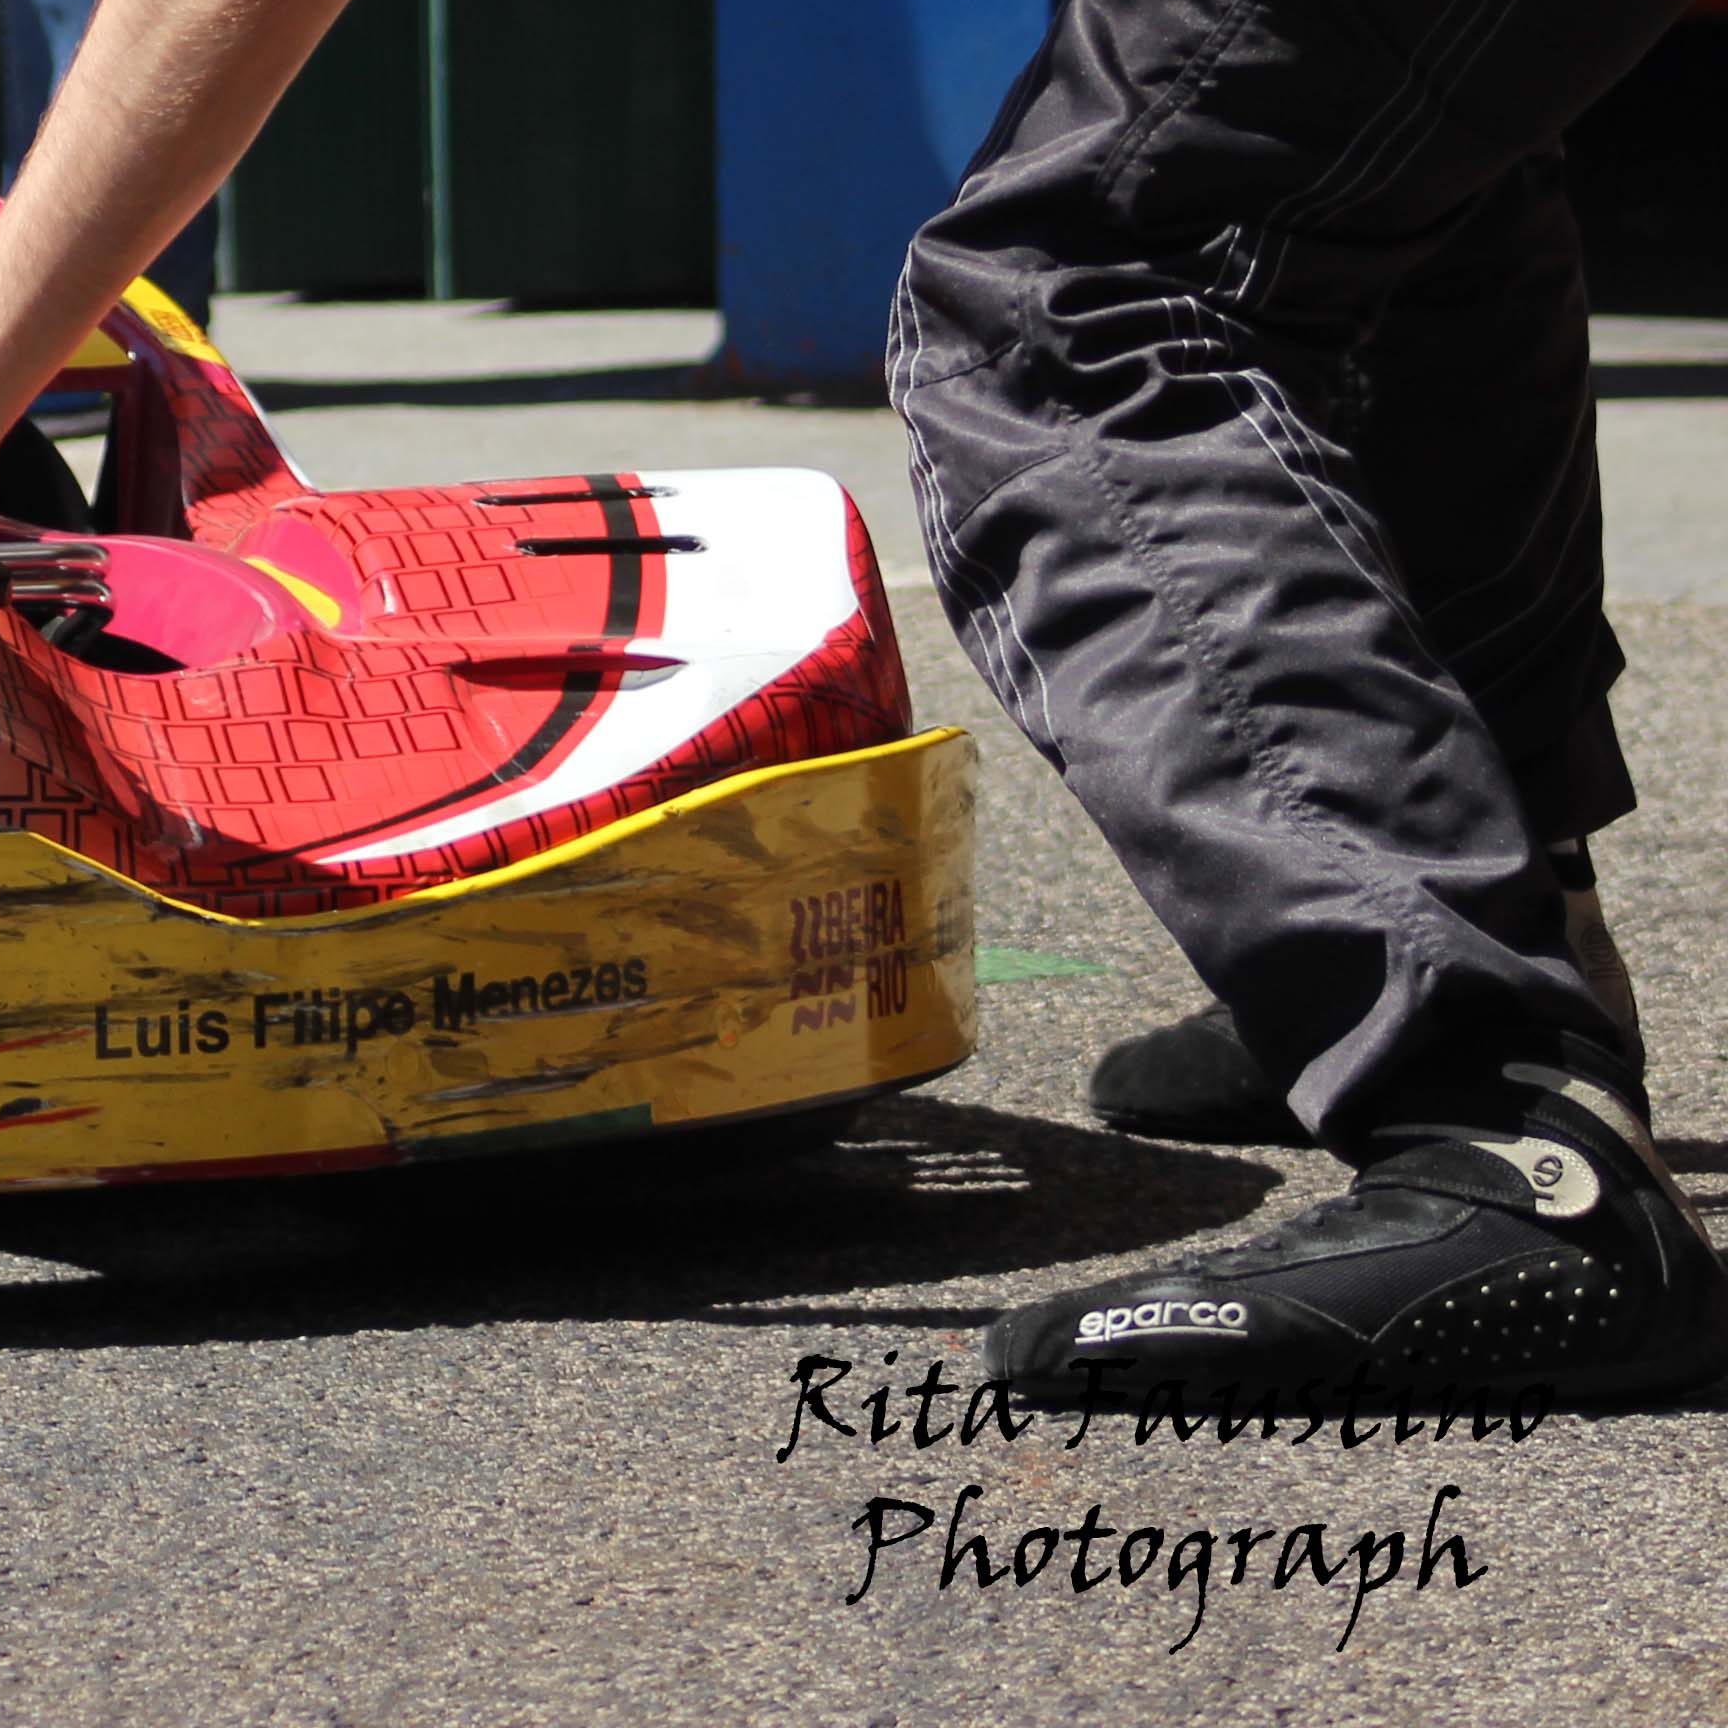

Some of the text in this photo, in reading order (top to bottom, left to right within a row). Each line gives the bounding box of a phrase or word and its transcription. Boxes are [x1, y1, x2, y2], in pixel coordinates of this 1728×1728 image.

[94, 957, 649, 1061] Luis Filipe Menezes
[865, 949, 907, 1019] RIO
[1077, 1297, 1248, 1342] sparco
